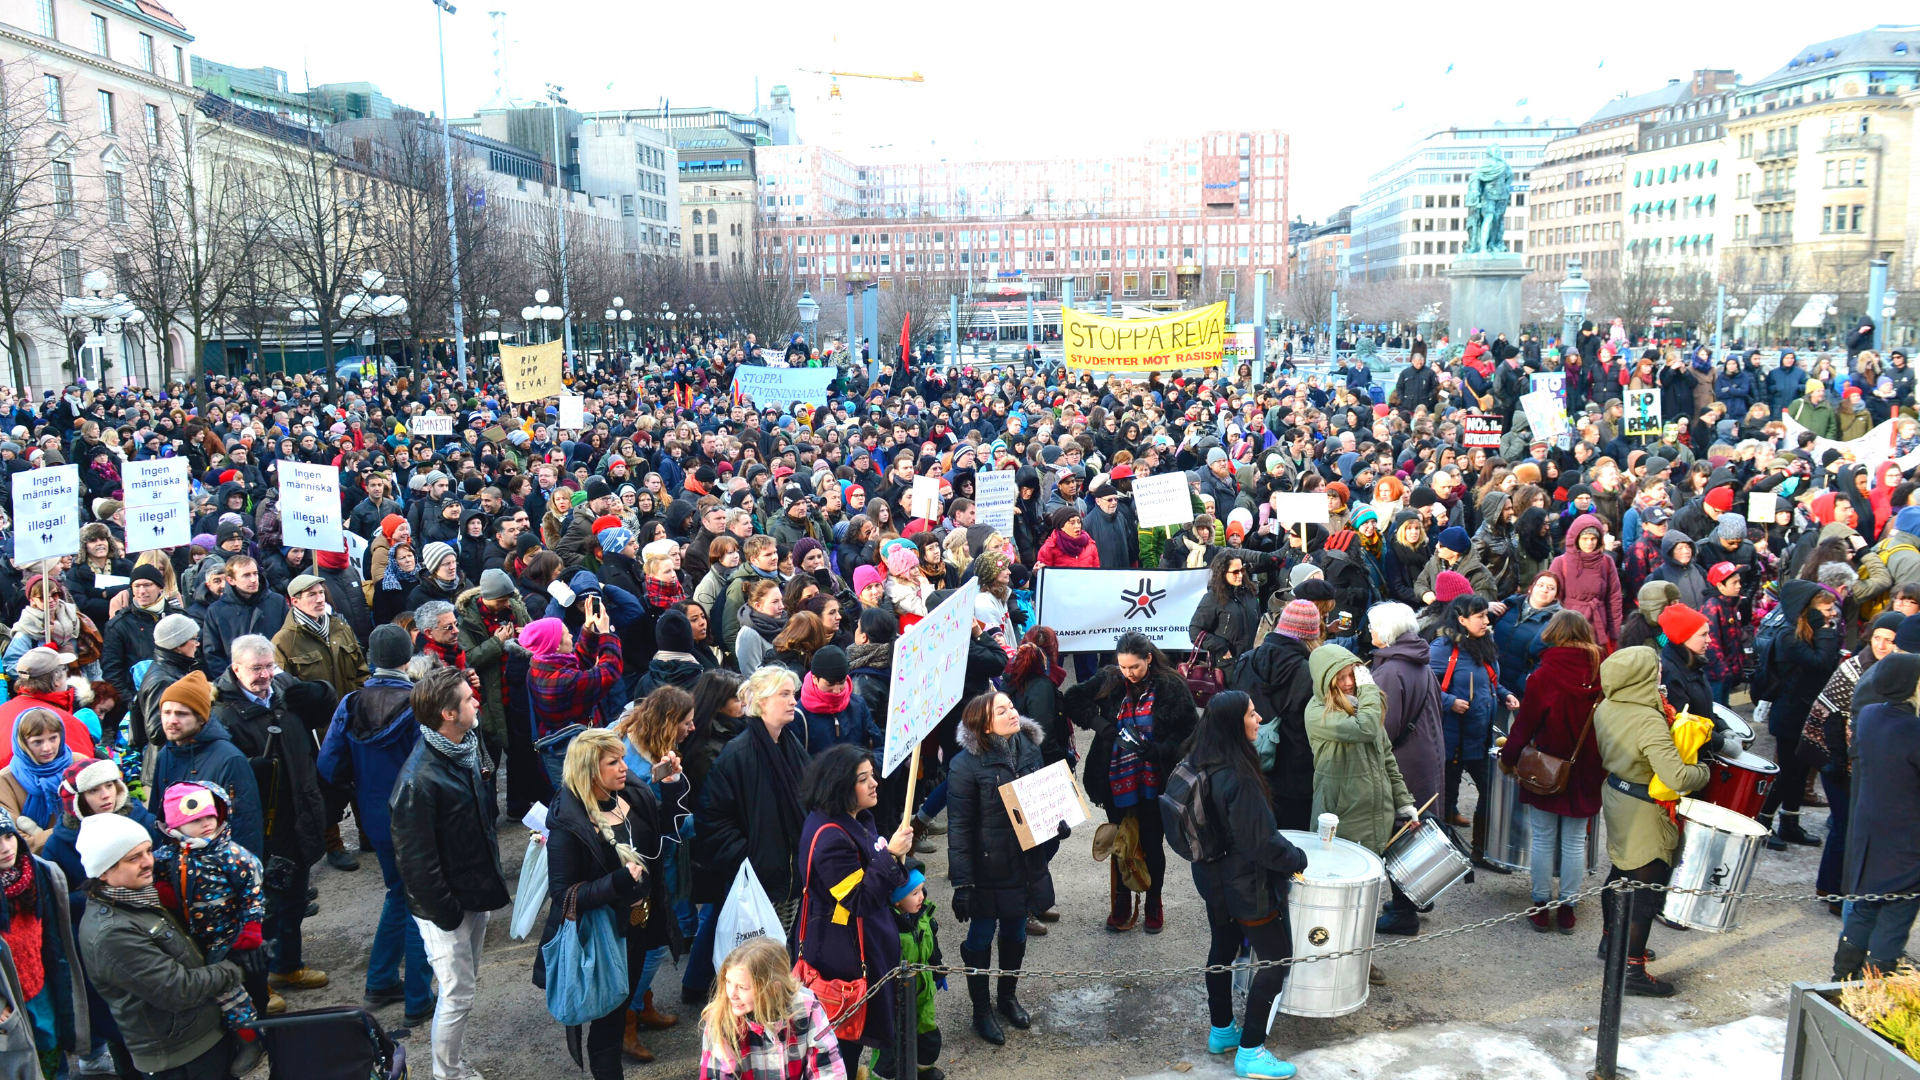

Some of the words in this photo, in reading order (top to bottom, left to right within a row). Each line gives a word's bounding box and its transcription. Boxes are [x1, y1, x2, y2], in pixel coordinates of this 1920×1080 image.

[1070, 321, 1164, 350] STOPPA
[1171, 318, 1222, 349] REVA
[1070, 353, 1139, 366] STUDENTER
[1142, 354, 1170, 366] MOT
[1175, 350, 1223, 364] RASISM
[520, 365, 538, 377] UPP
[515, 375, 547, 391] REVA!
[741, 372, 783, 384] STOPPA
[741, 385, 828, 399] UTVISNINGARNA
[1630, 392, 1654, 407] NO
[1490, 419, 1503, 431] the
[1628, 415, 1660, 433] REVA
[141, 466, 170, 477] Ingen
[294, 468, 322, 480] Ingen
[33, 474, 62, 487] Ingen
[131, 476, 180, 490] människa
[286, 480, 332, 492] människa
[22, 486, 72, 501] människa
[152, 490, 163, 499] är
[980, 486, 1009, 494] restriktiva
[304, 493, 315, 502] är
[41, 500, 52, 510] är
[139, 508, 178, 523] illegal!
[292, 510, 329, 525] illegal!
[28, 514, 67, 532] illegal!
[1055, 629, 1087, 637] RANSKA
[1088, 626, 1143, 636] FLYKTINGARS
[1144, 624, 1190, 634] RIKSFÖRBU
